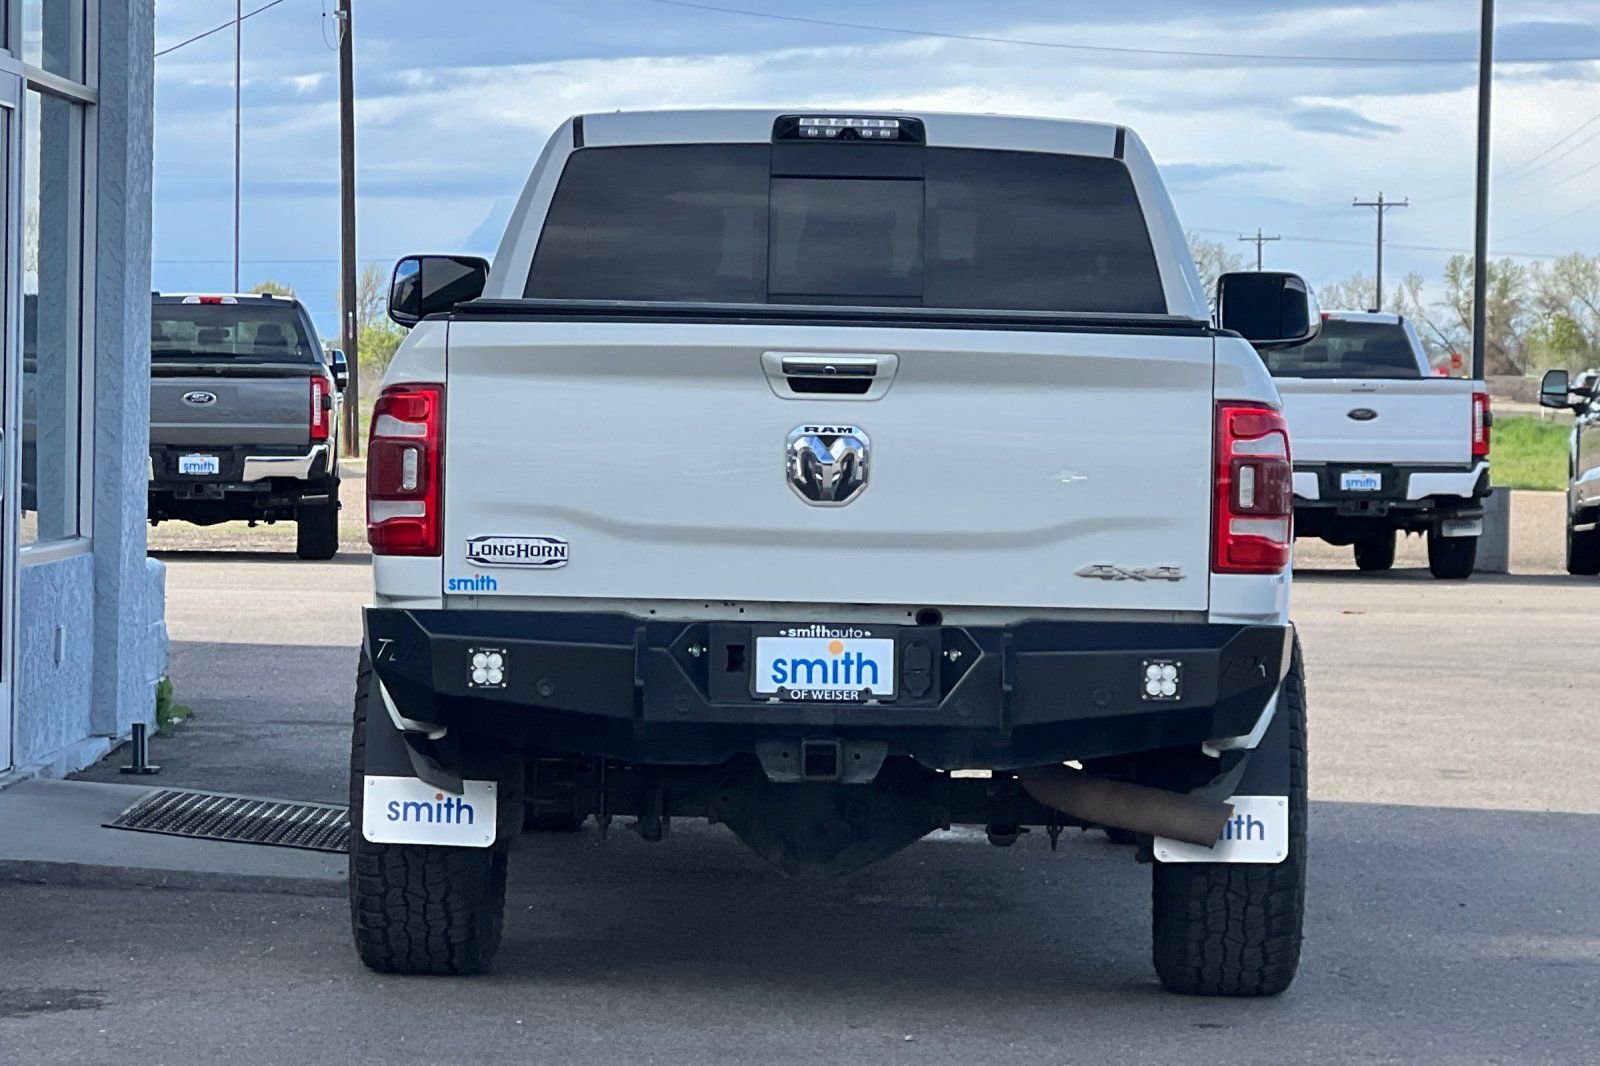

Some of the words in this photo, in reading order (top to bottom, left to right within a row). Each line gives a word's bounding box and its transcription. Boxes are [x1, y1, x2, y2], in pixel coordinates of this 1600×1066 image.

[804, 426, 853, 434] RAM
[183, 458, 215, 471] smith
[448, 573, 497, 591] smith
[771, 639, 878, 685] smith
[790, 690, 808, 700] OF
[811, 690, 859, 700] WEISER
[386, 792, 474, 825] smith
